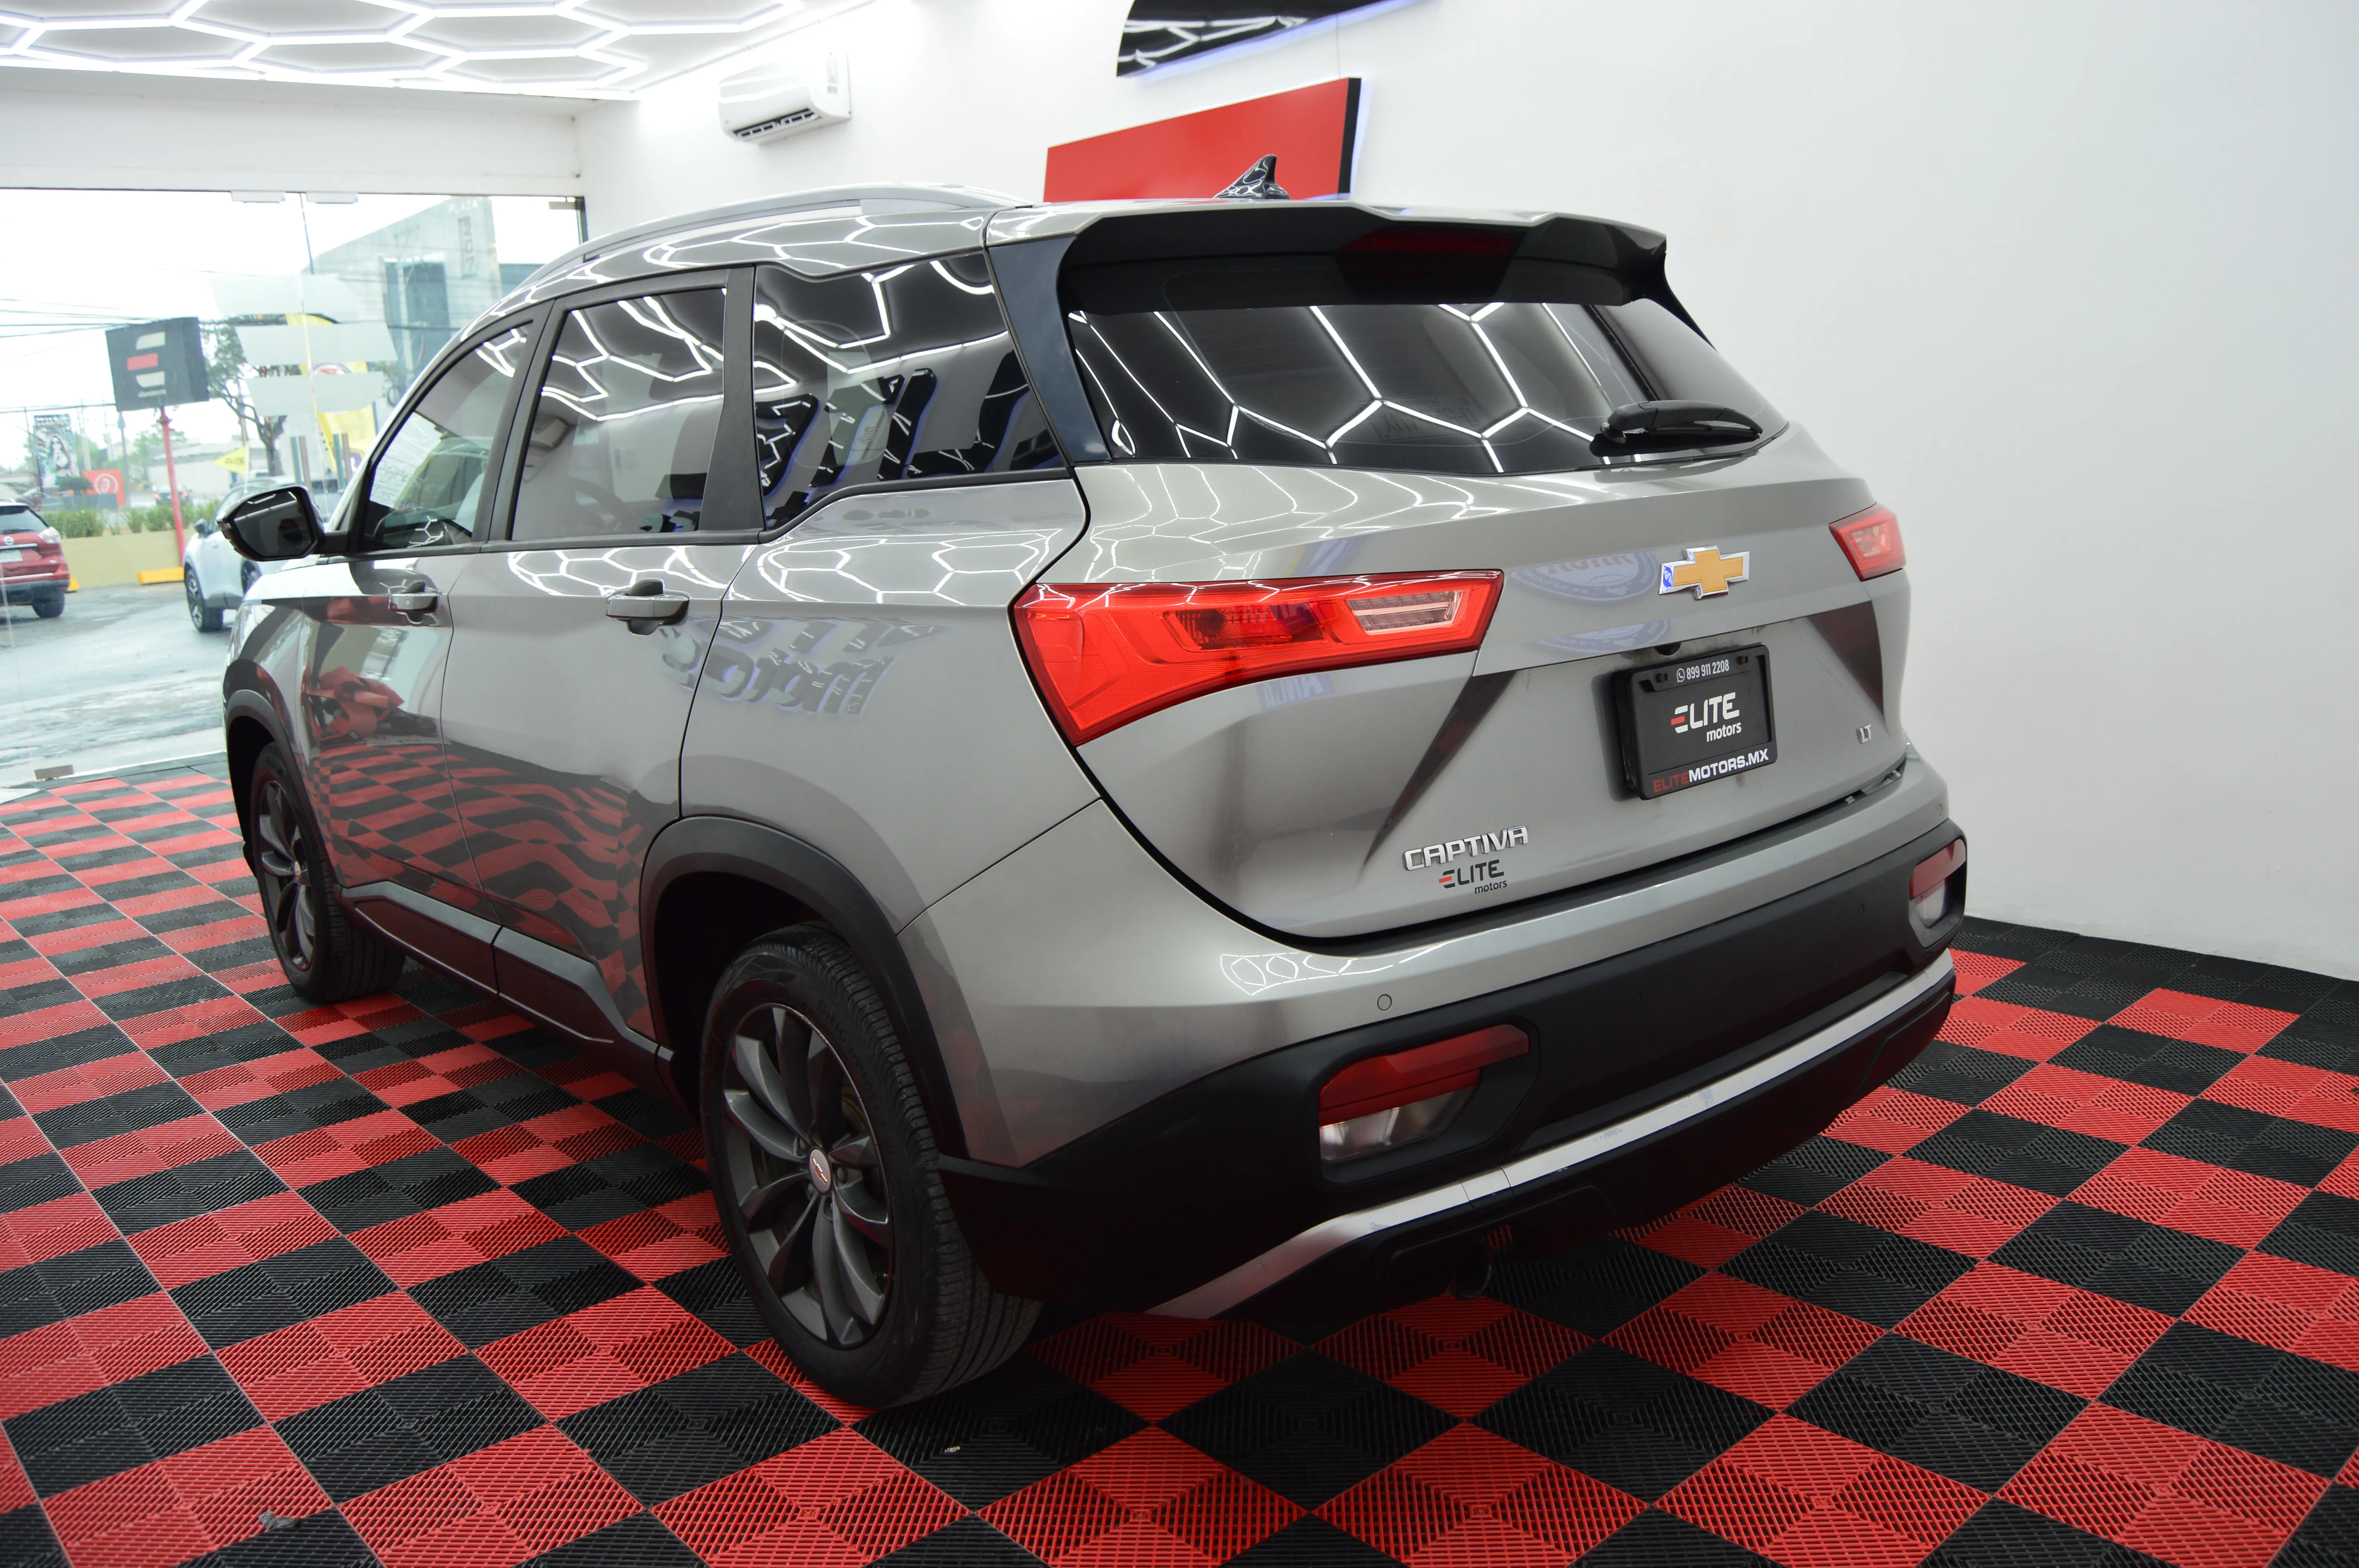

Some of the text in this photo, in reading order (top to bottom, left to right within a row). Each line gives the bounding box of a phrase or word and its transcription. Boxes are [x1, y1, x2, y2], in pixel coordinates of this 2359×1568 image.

[463, 221, 474, 271] 207
[1686, 659, 1730, 680] 899 911 2208
[1671, 691, 1740, 733] ELITE
[1706, 722, 1742, 742] motors
[1857, 724, 1872, 743] LT
[1653, 749, 1769, 792] ELITEMOTORS.MX
[1403, 825, 1529, 870] CAPTIVA
[1439, 859, 1505, 889] ELITE
[1474, 880, 1507, 894] motors
